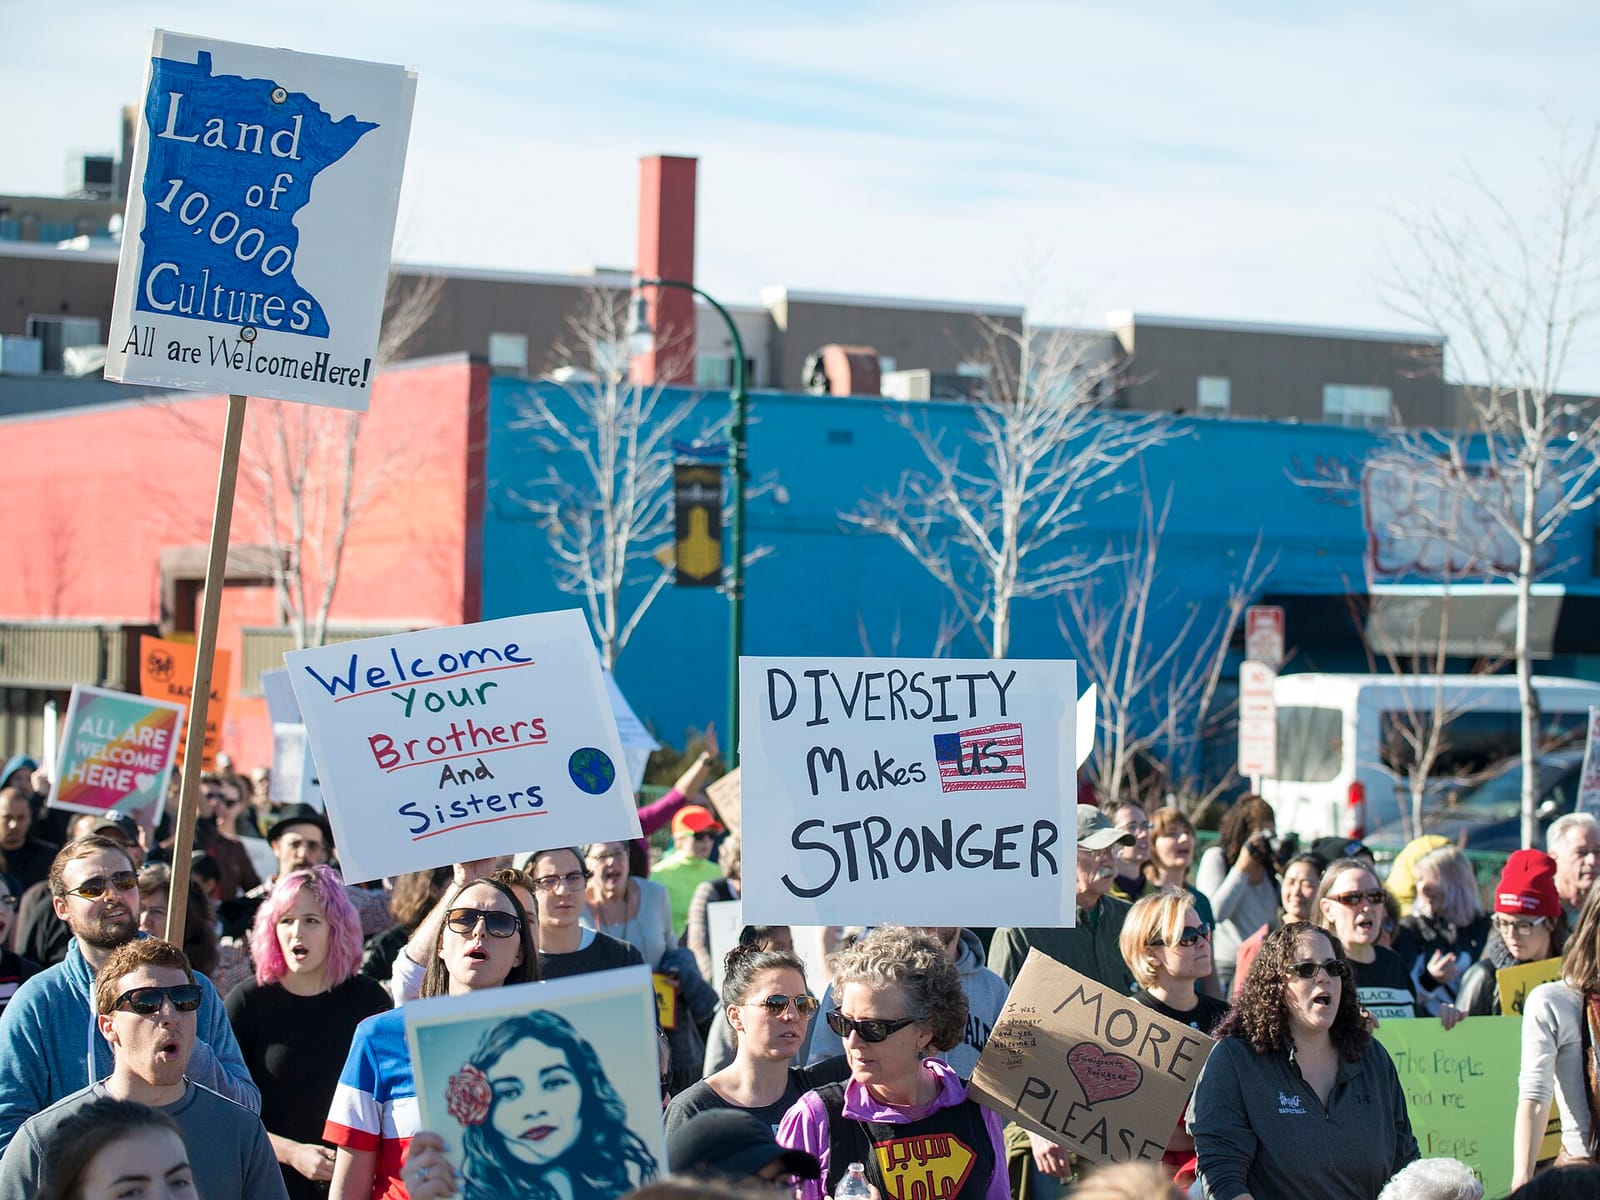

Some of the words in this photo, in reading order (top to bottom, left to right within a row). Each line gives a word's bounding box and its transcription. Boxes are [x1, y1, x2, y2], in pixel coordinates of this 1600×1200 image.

[157, 92, 303, 160] Land
[245, 173, 294, 211] of
[155, 178, 293, 277] 10,000
[145, 262, 313, 332] Cultures
[121, 324, 156, 357] All
[167, 340, 202, 364] are
[304, 642, 534, 696] Welcome
[766, 668, 1017, 727] DIVERSITY
[74, 739, 163, 772] WELCOME
[78, 716, 117, 741] ALL
[121, 724, 169, 751] ARE
[367, 717, 548, 770] Brothers
[66, 760, 132, 793] HERE
[438, 757, 494, 789] And
[806, 745, 927, 796] Makes
[398, 785, 545, 834] Sisters
[780, 815, 1059, 899] STRONGER
[1007, 1002, 1017, 1013] I
[1020, 1006, 1036, 1014] was
[1007, 1017, 1043, 1028] stranger
[1053, 984, 1200, 1082] MORE
[1395, 1048, 1425, 1075] The
[1442, 1092, 1466, 1109] me
